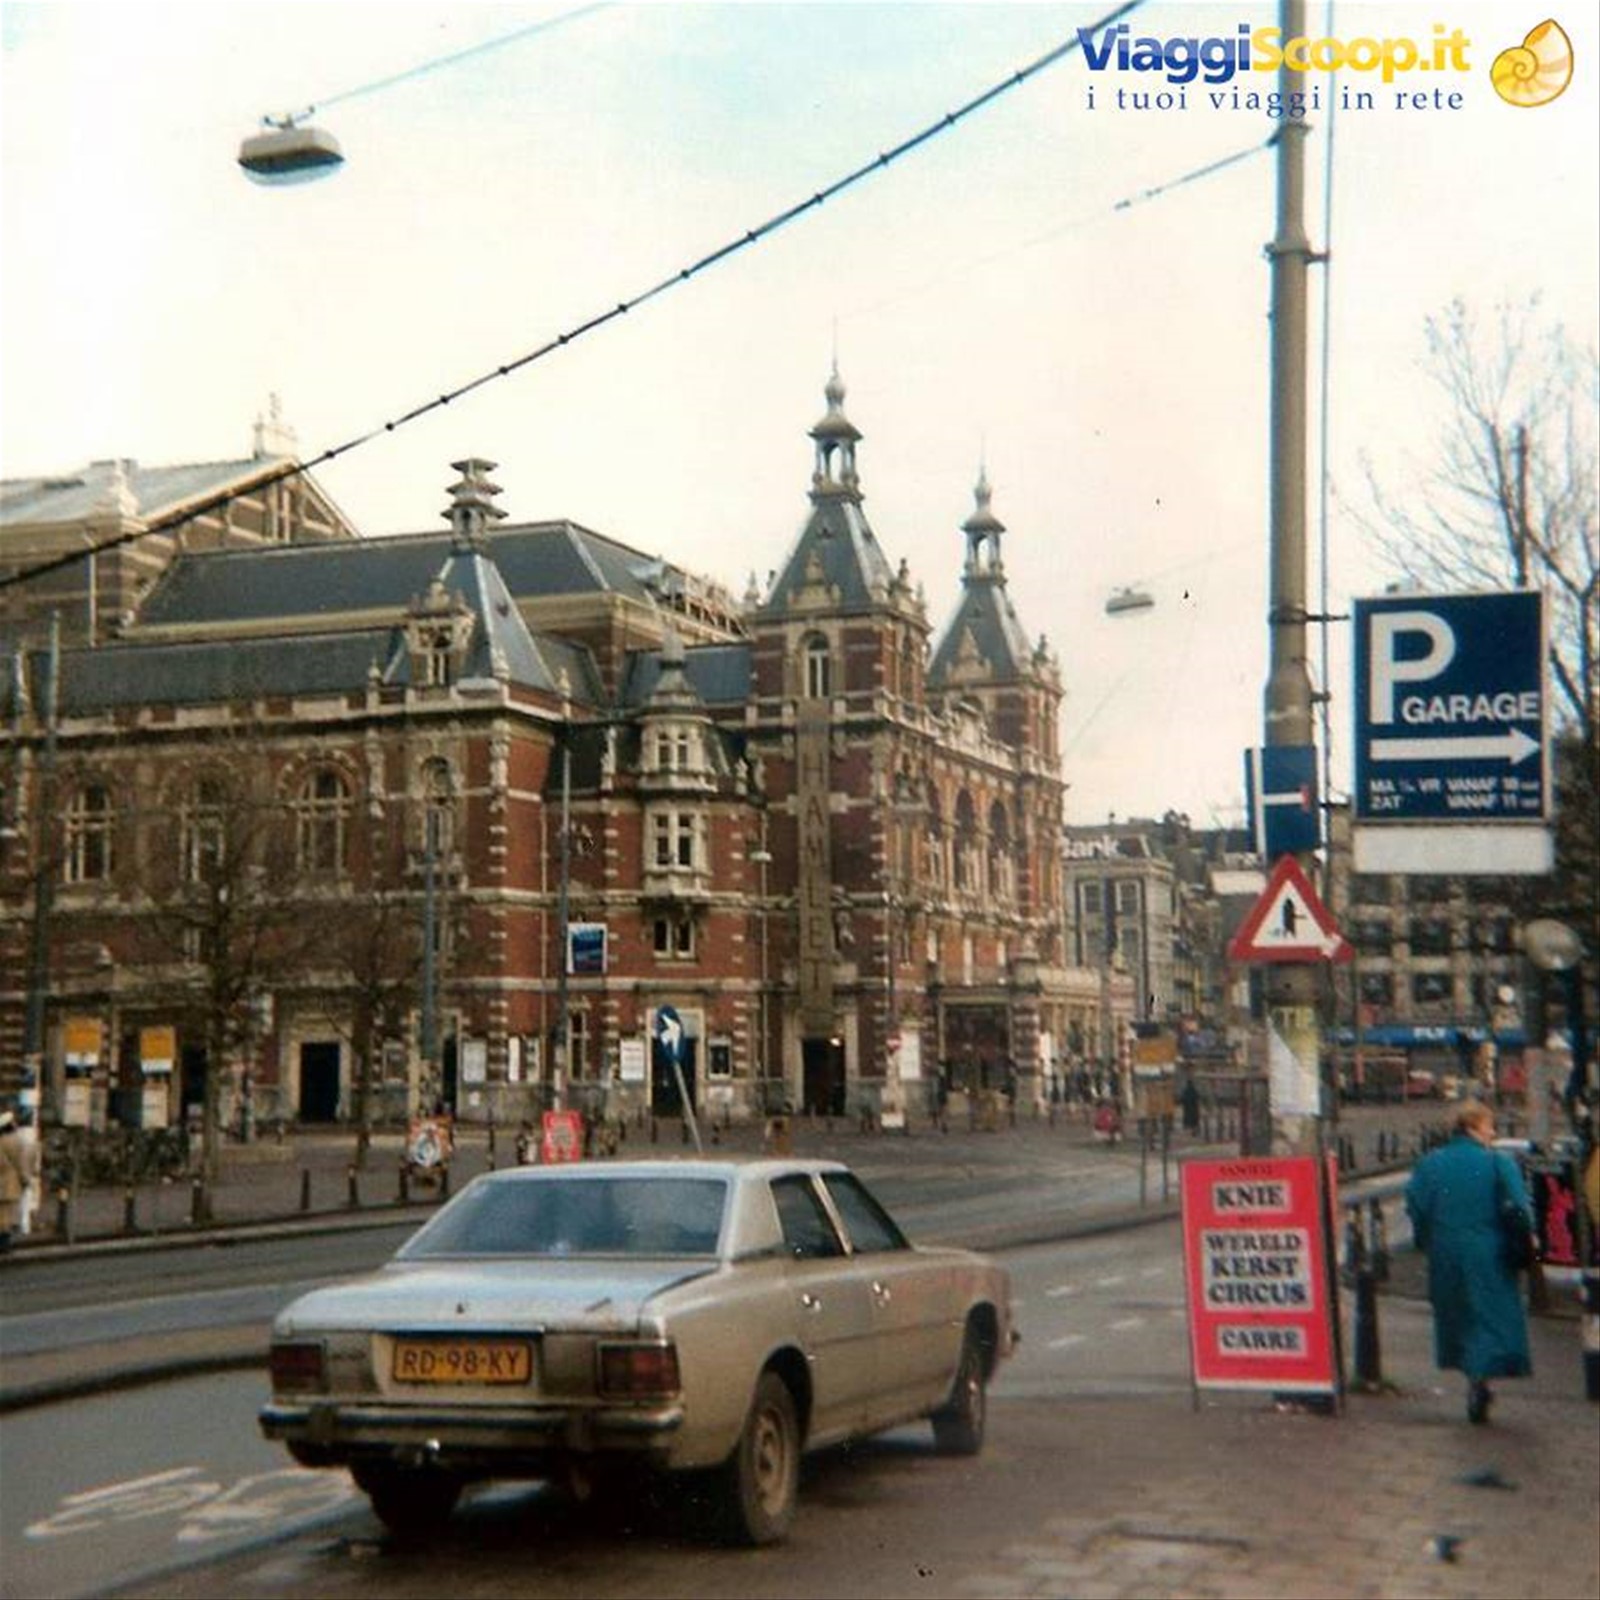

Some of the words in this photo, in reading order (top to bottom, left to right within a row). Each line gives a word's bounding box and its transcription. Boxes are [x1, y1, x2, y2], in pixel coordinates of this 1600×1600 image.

[1370, 610, 1456, 724] P
[1402, 692, 1539, 723] GARAGE
[1217, 1186, 1284, 1207] KNIE
[1207, 1233, 1300, 1250] WERELD
[1212, 1257, 1298, 1277] KERST
[1209, 1284, 1306, 1304] CIRCUS
